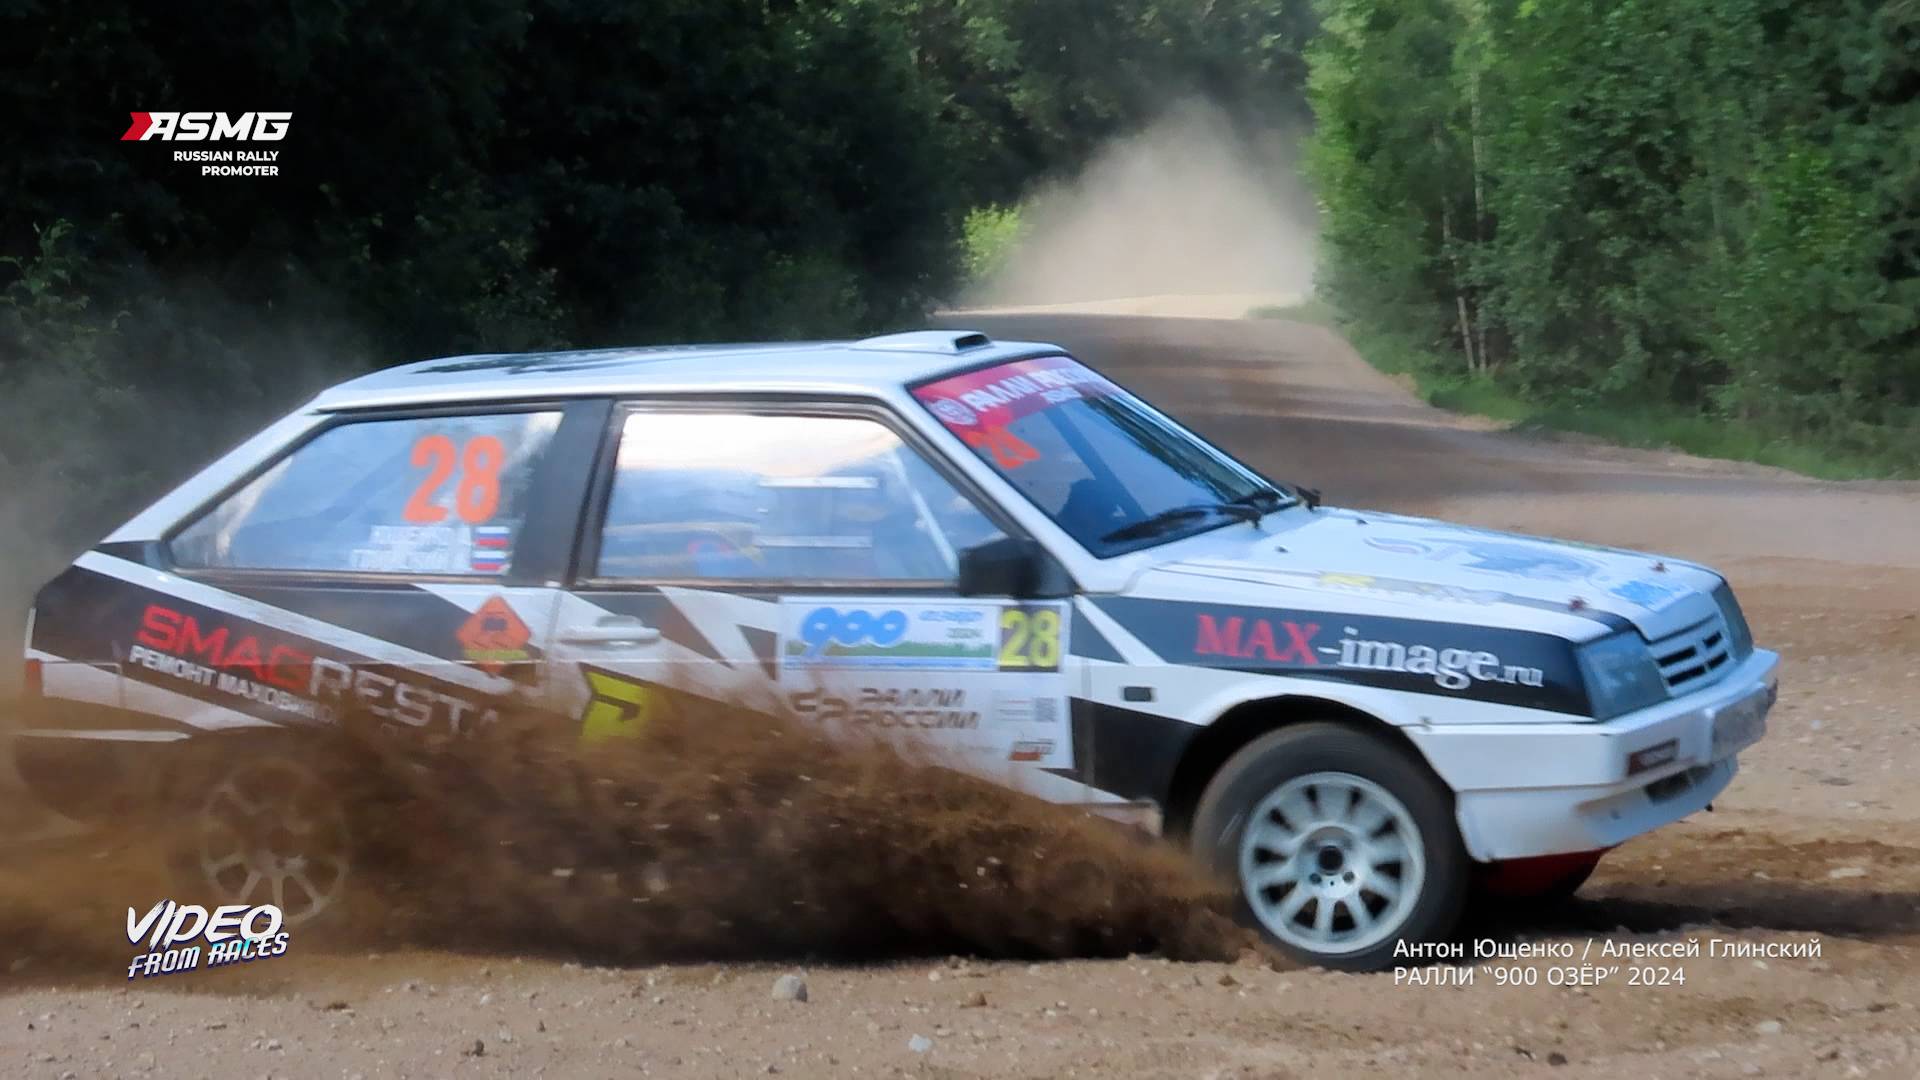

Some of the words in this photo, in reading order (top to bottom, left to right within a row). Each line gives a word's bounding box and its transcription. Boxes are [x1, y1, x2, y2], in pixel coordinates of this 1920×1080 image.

[403, 434, 505, 524] 28
[801, 606, 908, 658] 900
[1000, 609, 1060, 668] 28
[1194, 613, 1544, 690] MAX-image.ru
[128, 644, 218, 688] РЕМОНТ
